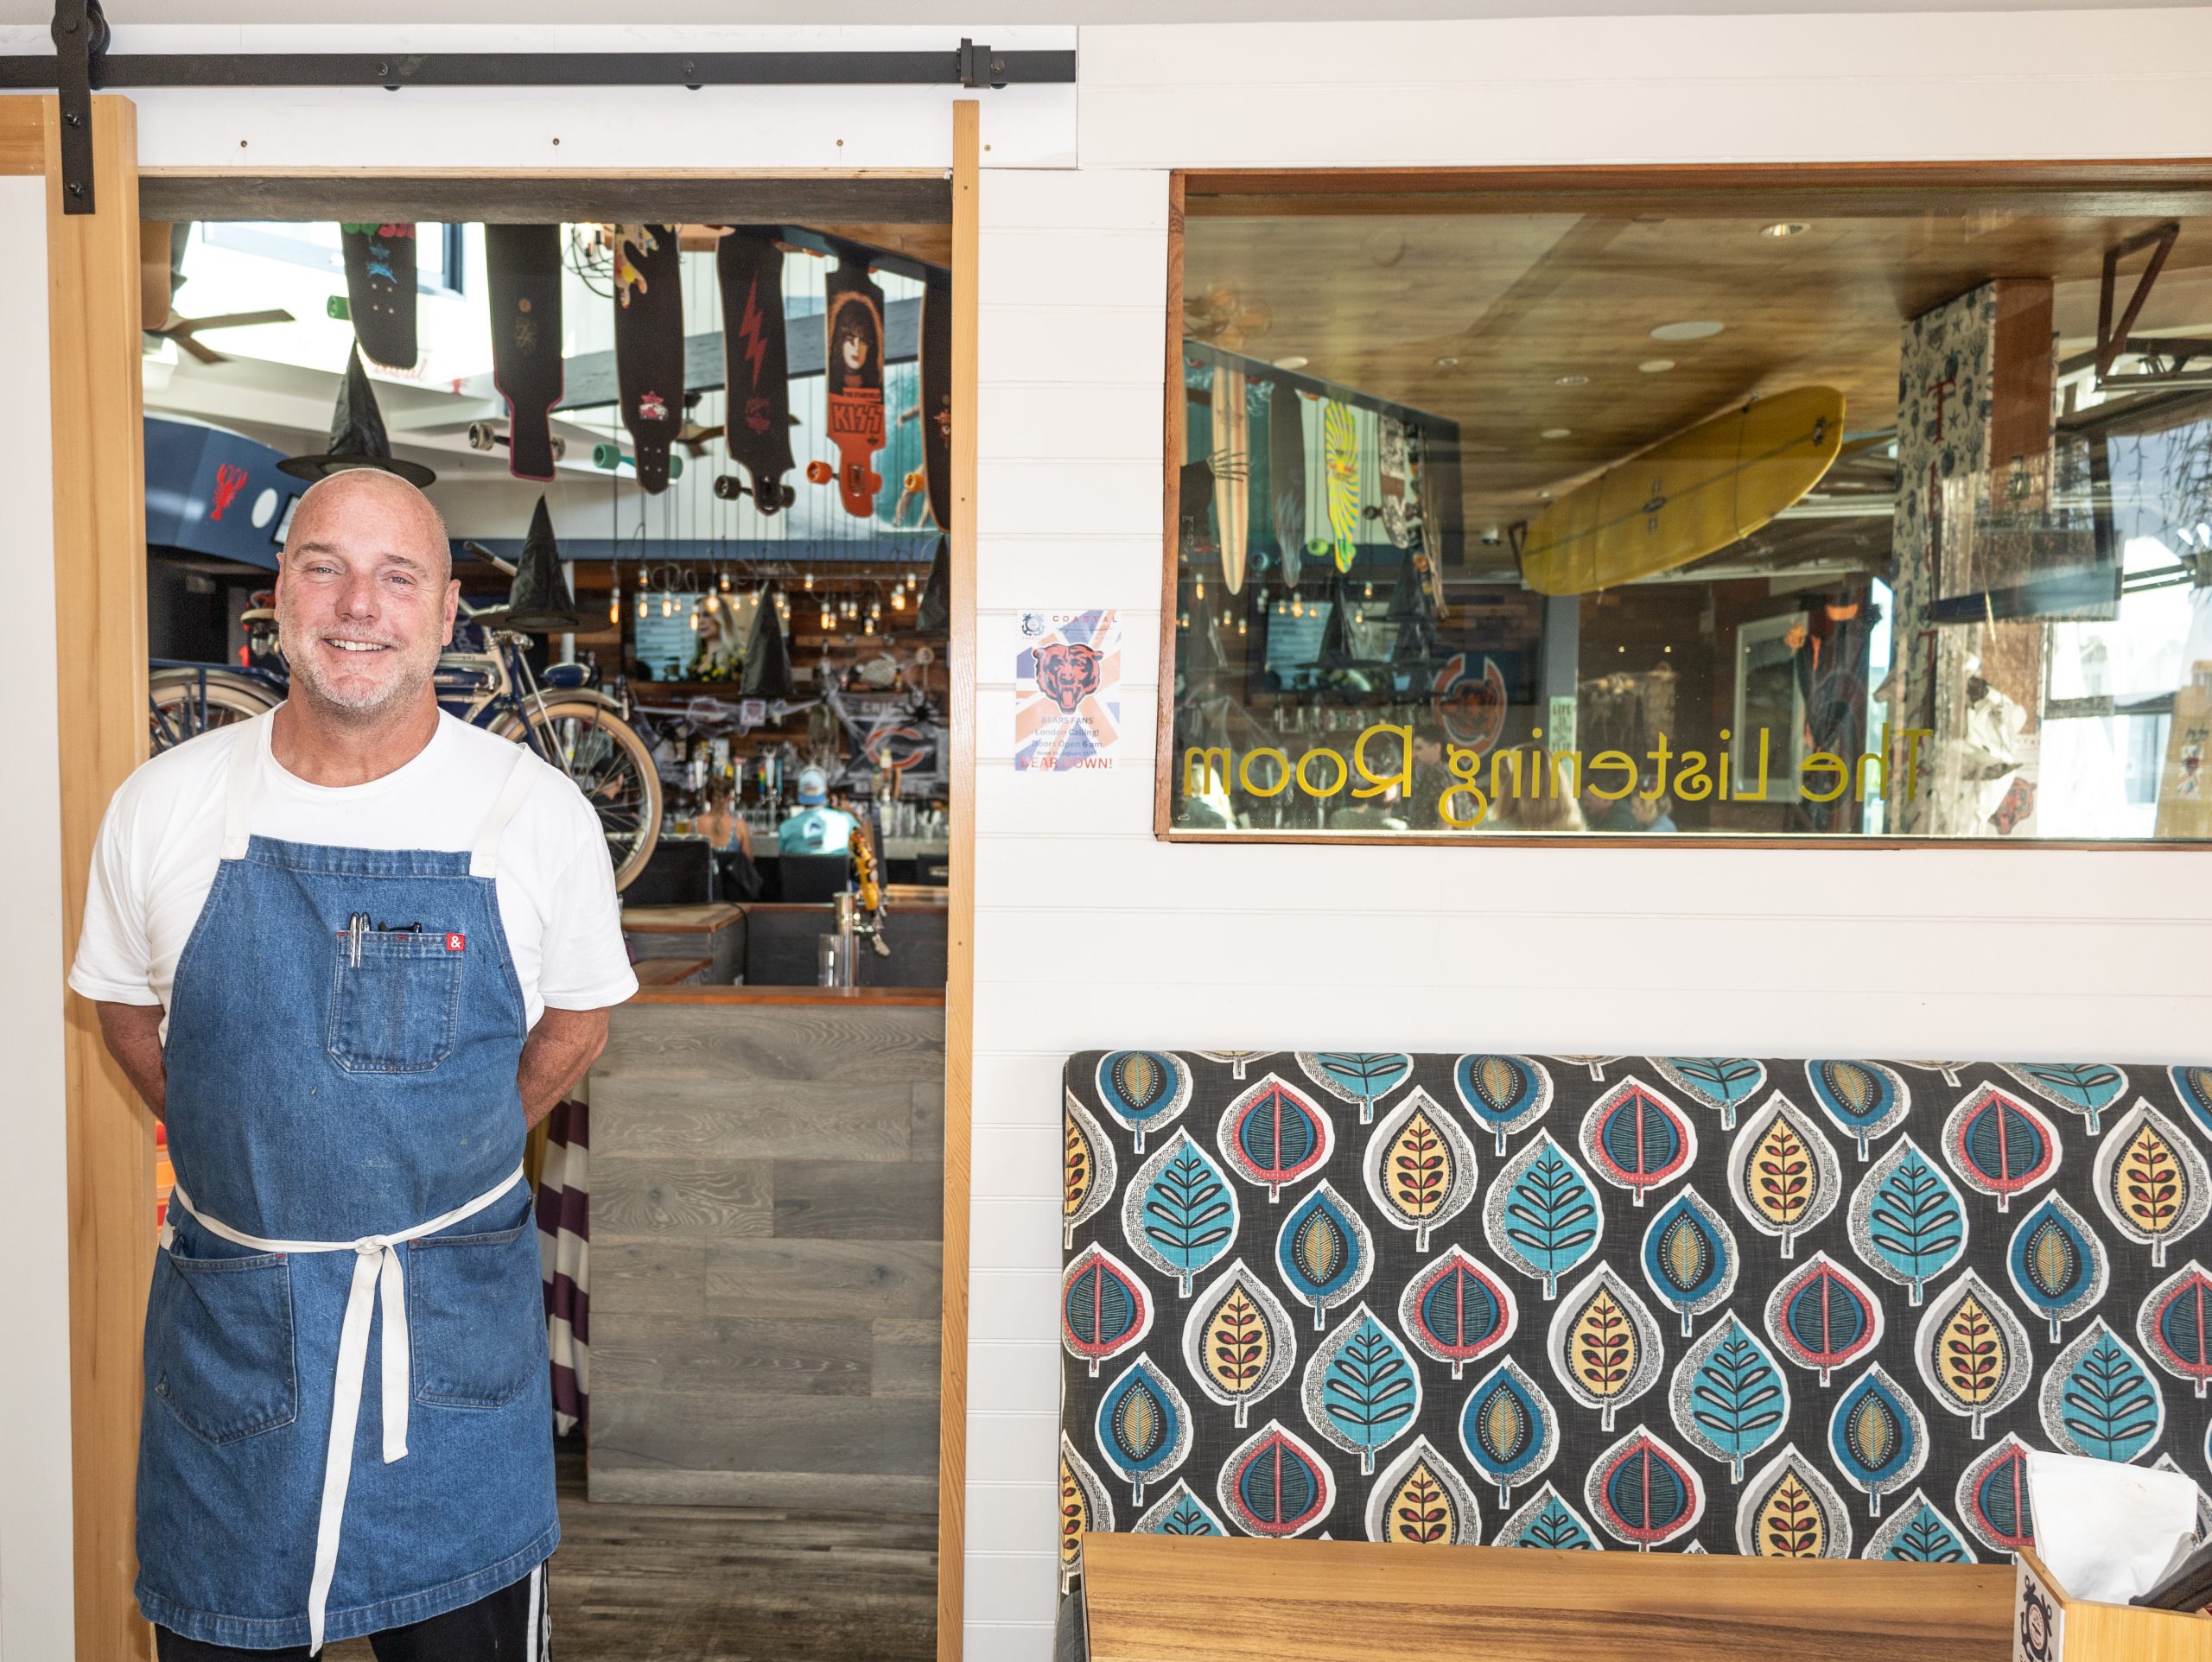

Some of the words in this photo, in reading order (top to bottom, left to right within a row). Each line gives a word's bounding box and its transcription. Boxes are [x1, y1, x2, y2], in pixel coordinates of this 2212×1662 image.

[830, 402, 883, 434] KISS
[1069, 728, 1099, 738] Calling!
[1058, 739, 1080, 749] Open
[1062, 758, 1112, 769] DOWN!
